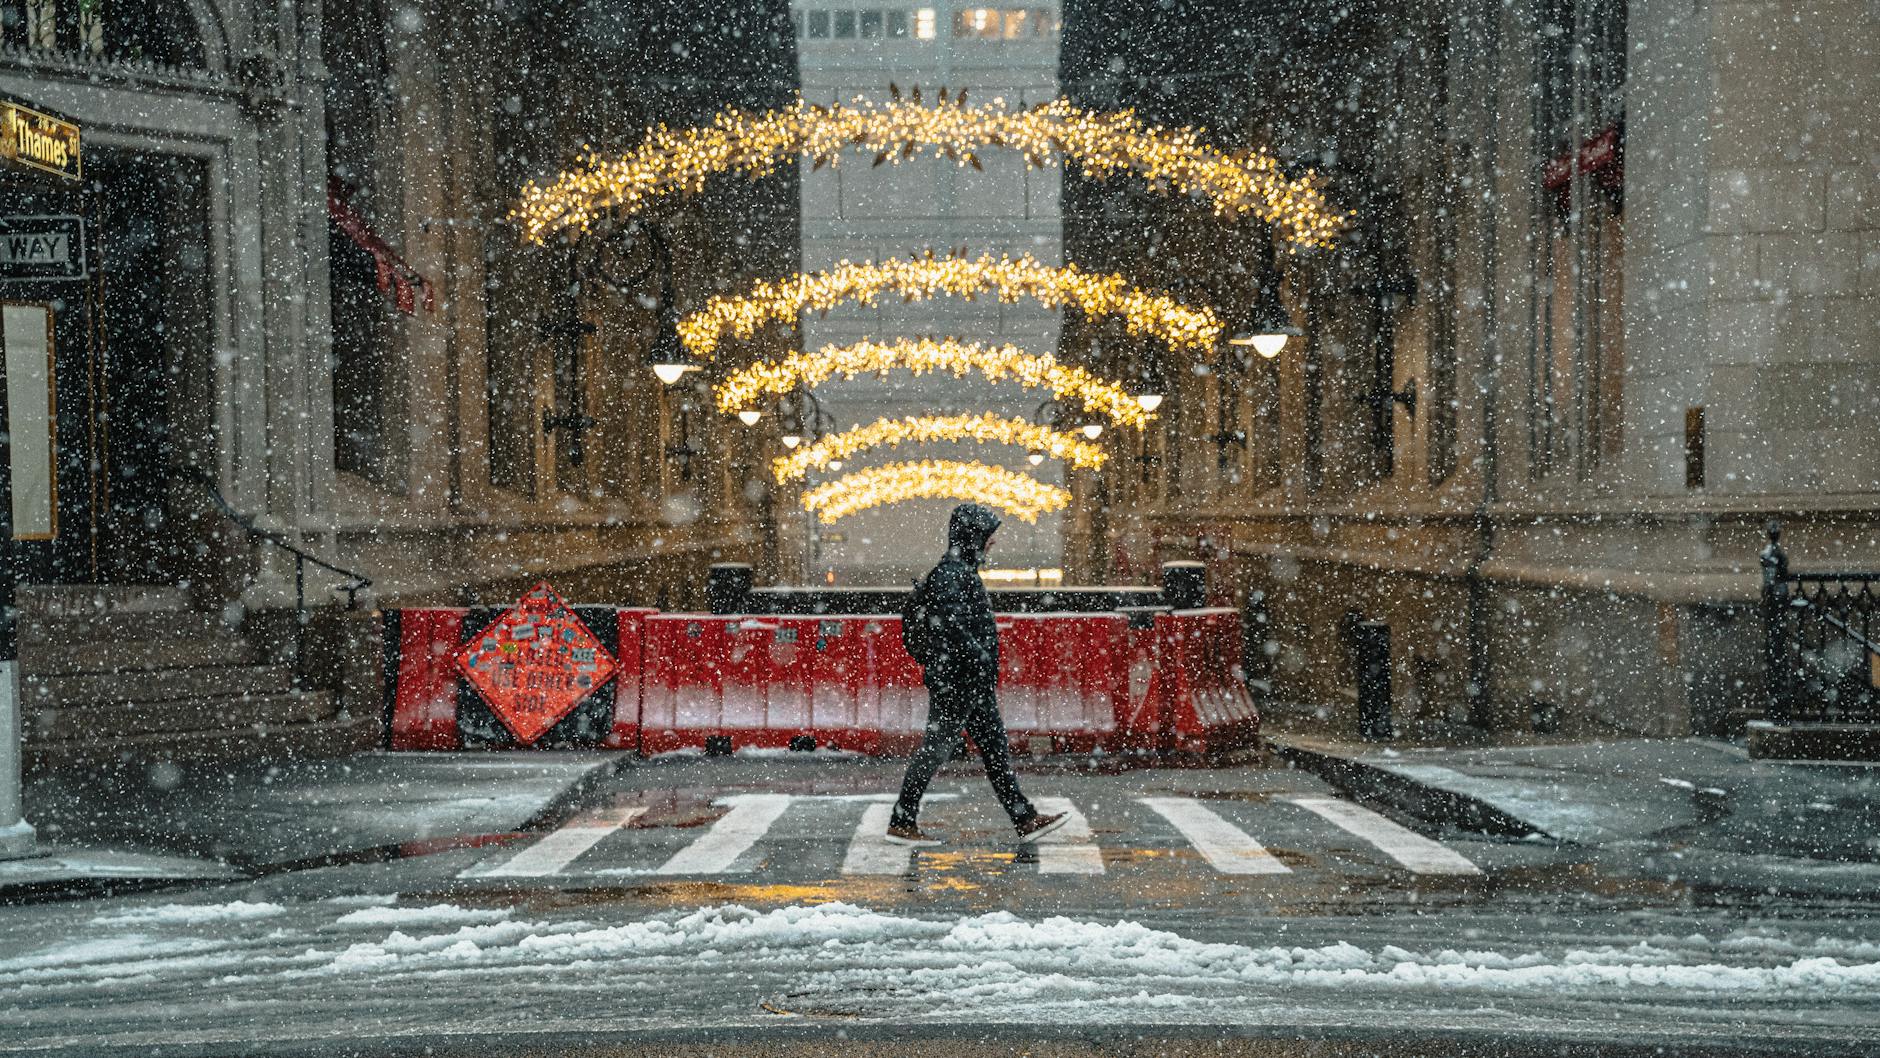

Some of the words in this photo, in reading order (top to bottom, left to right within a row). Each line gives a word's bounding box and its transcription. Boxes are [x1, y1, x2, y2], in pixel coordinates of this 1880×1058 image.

[17, 118, 68, 168] Thames
[8, 236, 61, 260] WAY
[491, 669, 520, 688] USE
[526, 671, 575, 691] OTHER
